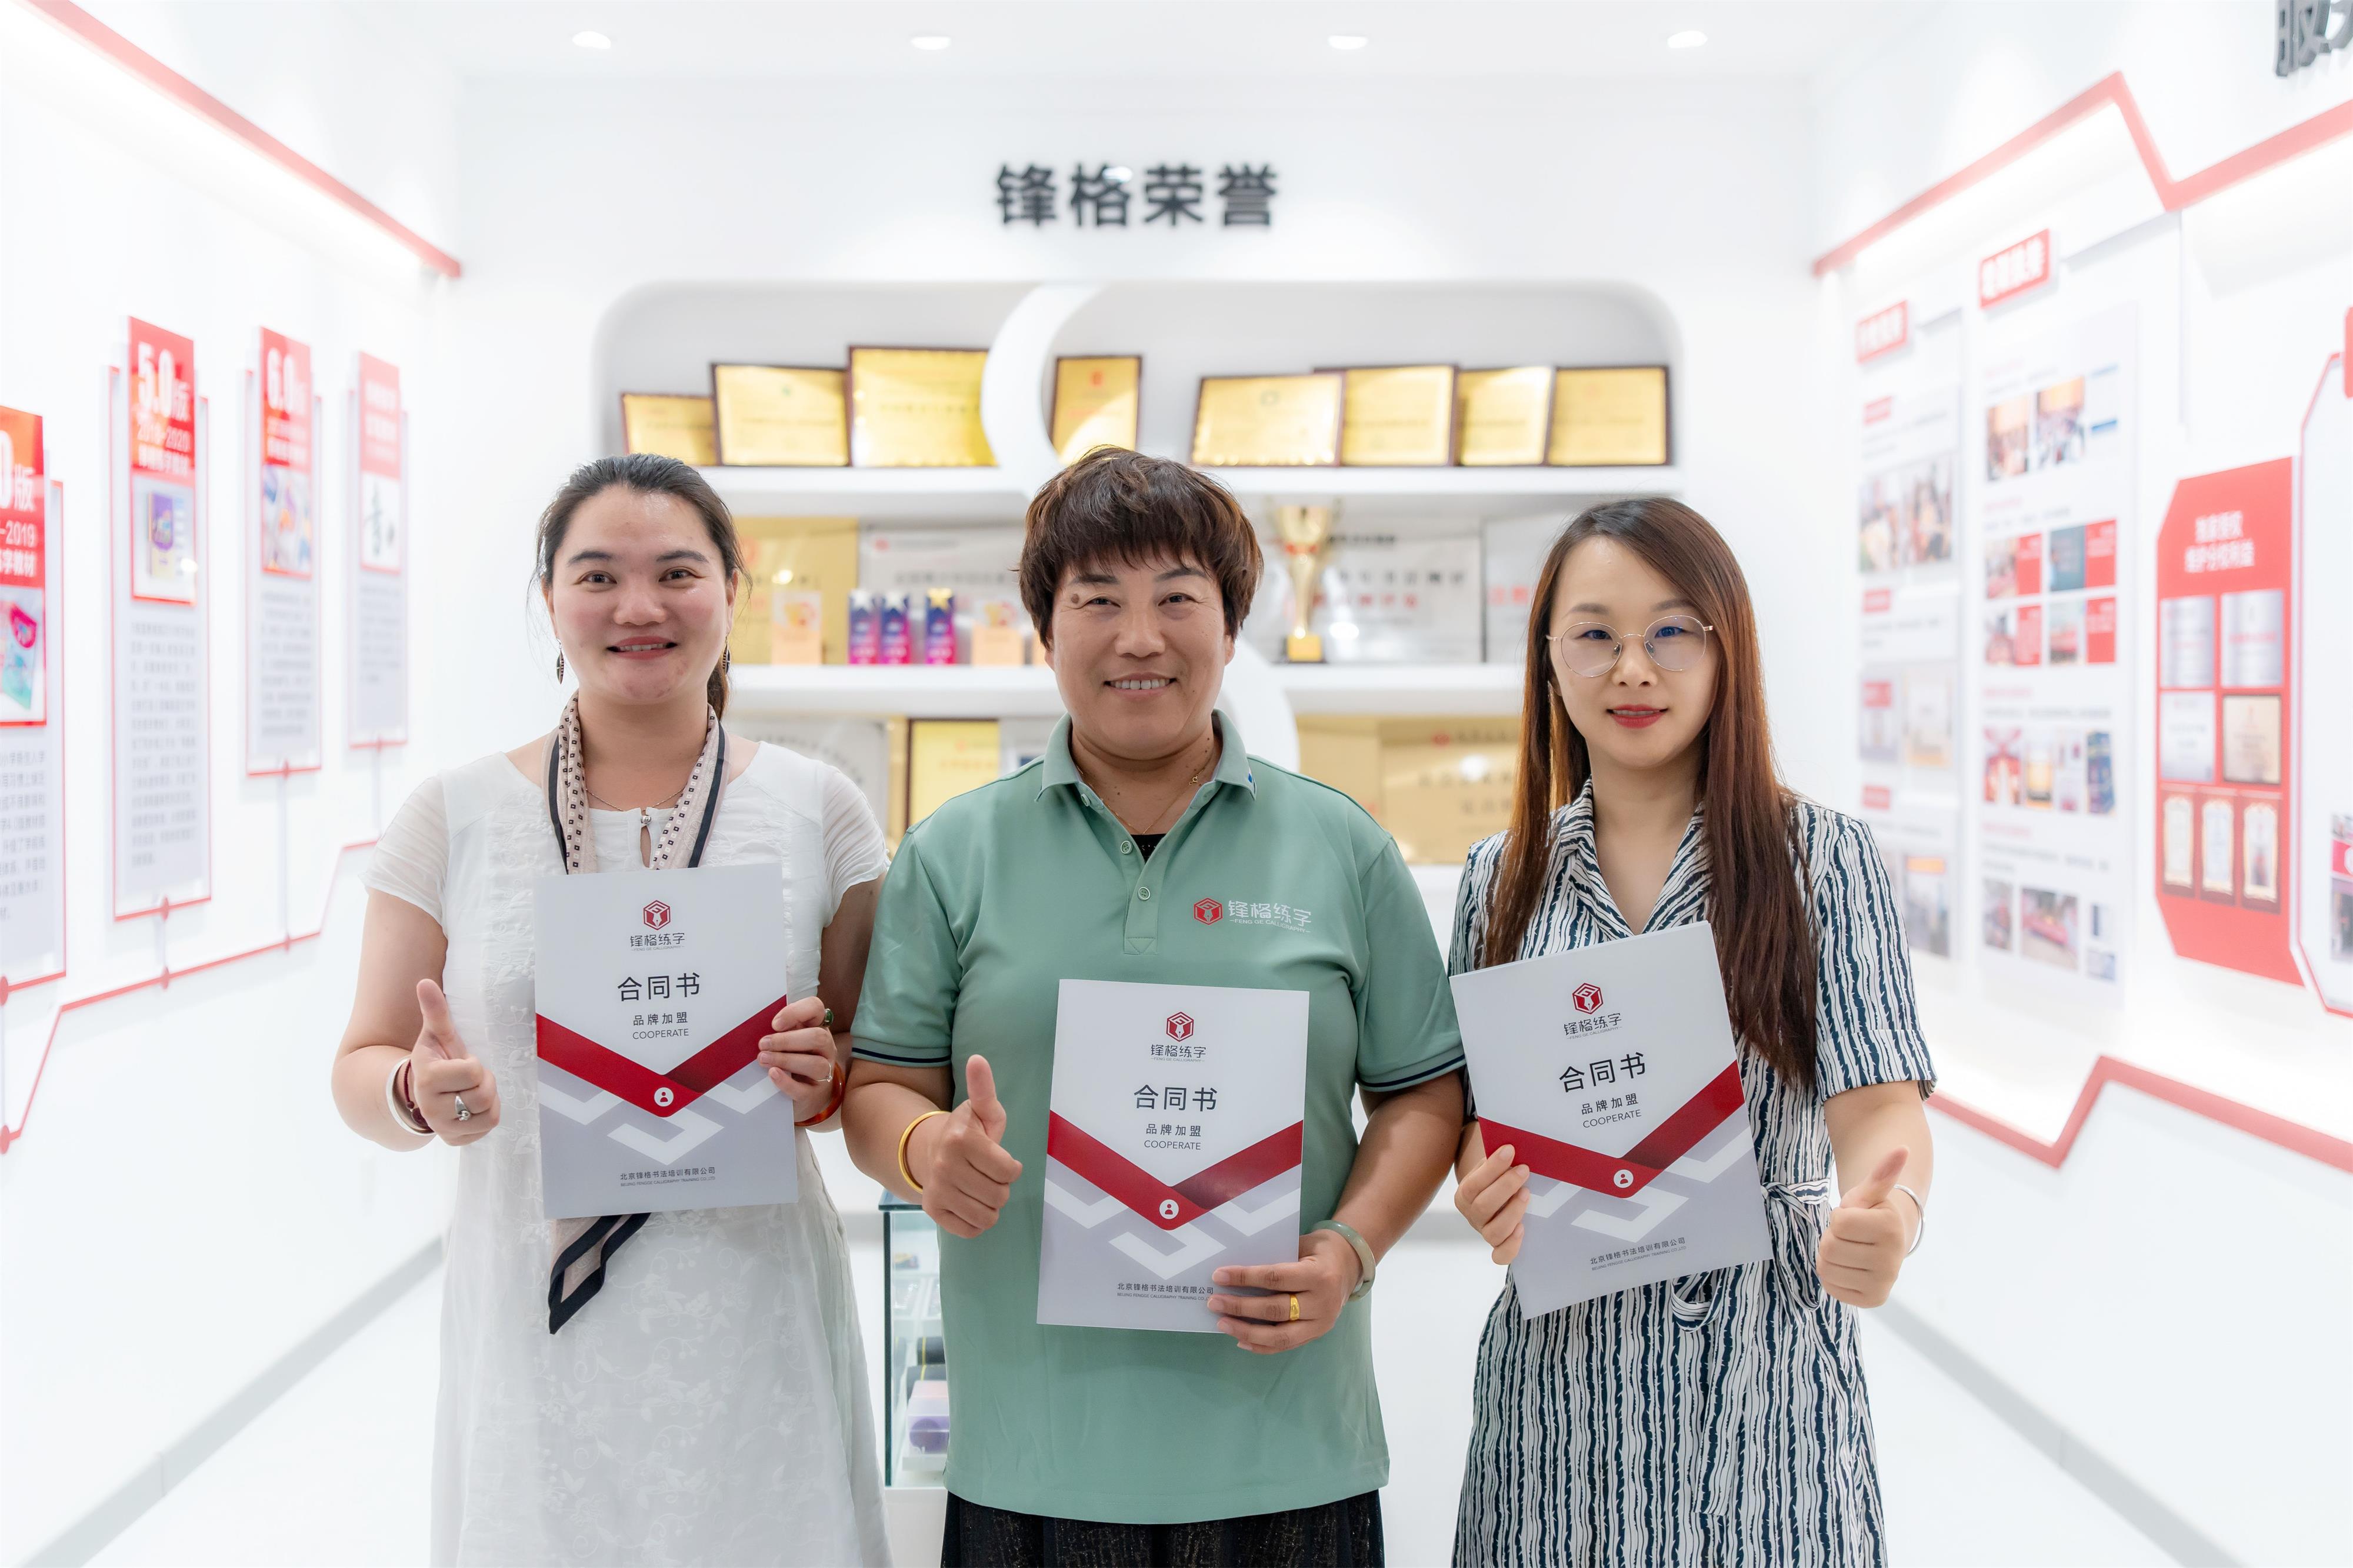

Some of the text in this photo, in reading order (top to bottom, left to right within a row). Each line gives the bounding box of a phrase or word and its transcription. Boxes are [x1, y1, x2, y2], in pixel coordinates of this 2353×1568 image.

[997, 164, 1277, 226] 锋格荣誉
[1228, 900, 1312, 927] 锋格练字
[1265, 920, 1306, 933] CALLIGRAPHY
[630, 933, 685, 947] 锋格练字
[618, 972, 700, 1002] 合同书
[633, 1012, 688, 1026] 品牌加盟
[1564, 1013, 1622, 1036] 锋格练字
[632, 1029, 689, 1039] COOPERATE
[1151, 1044, 1206, 1058] 锋格练字
[1559, 1052, 1646, 1093] 合同书
[1134, 1085, 1218, 1112] 合同书
[1581, 1093, 1638, 1115] 品牌加盟
[1582, 1109, 1642, 1128] COOPERATE
[1146, 1123, 1201, 1137] 品牌加盟
[1144, 1140, 1201, 1150] COOPERATE
[620, 1167, 715, 1180] 北京锋格书法培训有限公司
[1590, 1237, 1685, 1265] 北京锋格书法培训有限公司
[1117, 1283, 1214, 1295] 北京锋格书法培训有限公司
